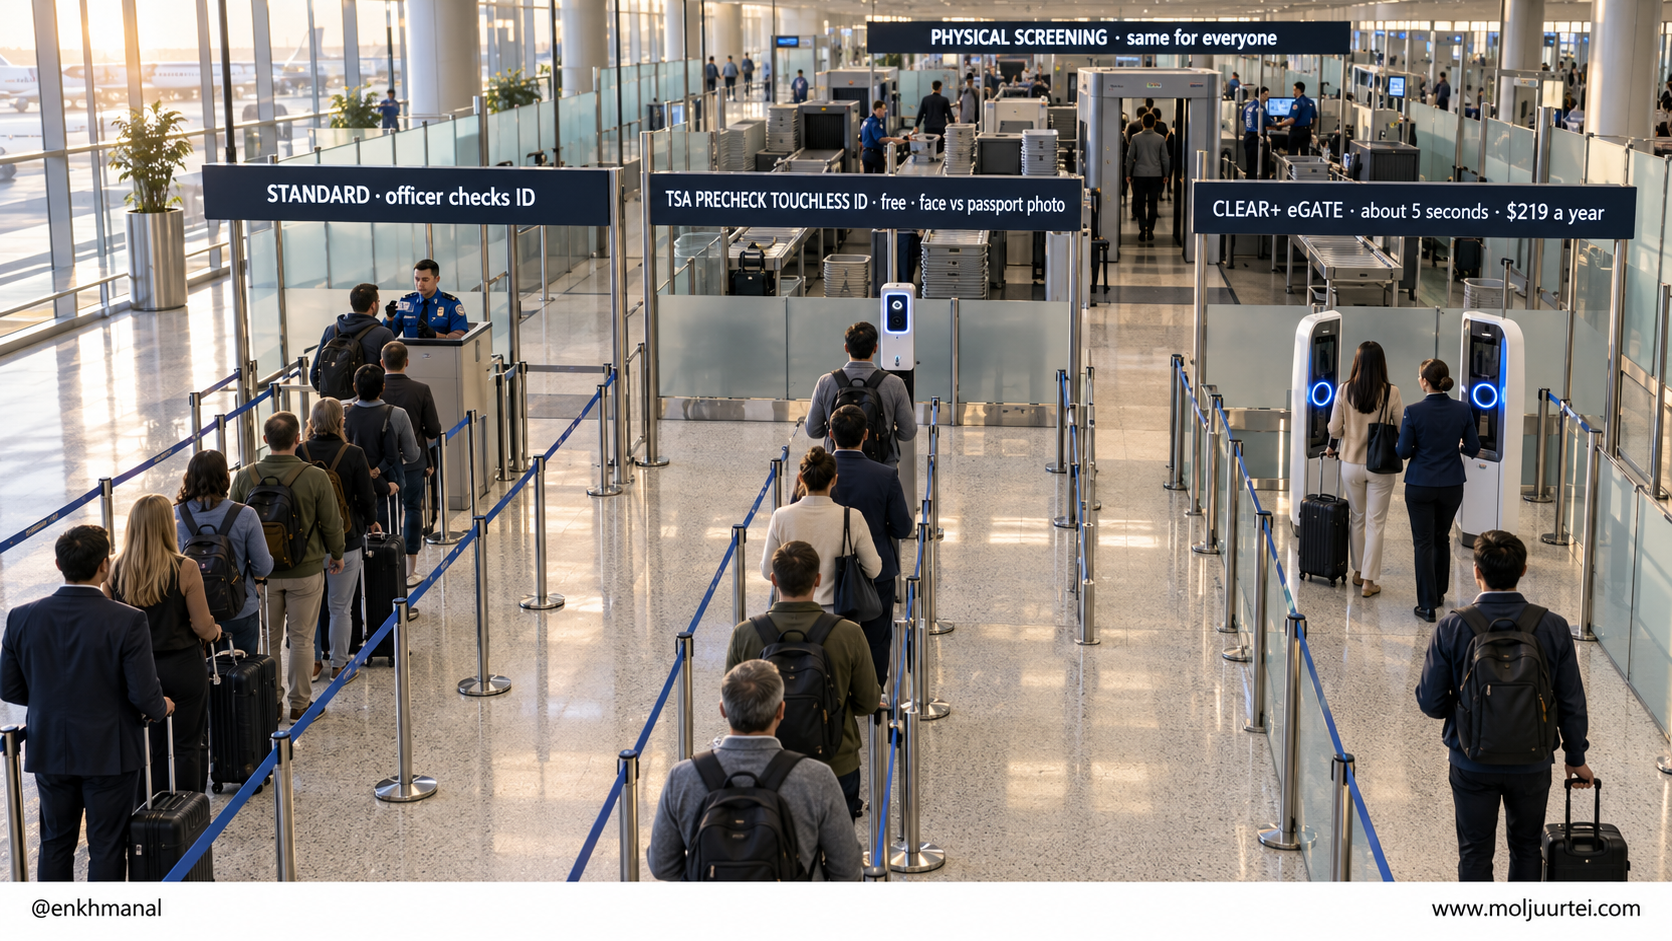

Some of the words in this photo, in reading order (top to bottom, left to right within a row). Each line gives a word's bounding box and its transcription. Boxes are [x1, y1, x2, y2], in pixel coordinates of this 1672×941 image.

[931, 28, 1011, 46] PHYSICAL
[1014, 28, 1108, 46] SCREENING
[1126, 32, 1170, 46] same
[1173, 27, 1199, 46] for
[1202, 32, 1278, 51] everyone
[266, 183, 371, 205] STANDARD
[385, 184, 444, 206] officer
[448, 185, 511, 207] checks
[516, 187, 536, 207] ID
[665, 190, 693, 208] TSA
[695, 190, 767, 209] PRECHECK
[769, 191, 850, 210] TOUCHLESS
[854, 192, 868, 210] ID
[880, 192, 907, 211] free
[918, 192, 947, 211] face
[949, 198, 964, 212] vs
[967, 196, 1024, 216] passport
[1027, 194, 1066, 217] photo
[1212, 199, 1282, 218] CLEAR+
[1287, 200, 1344, 219] eGATE
[1360, 201, 1407, 219] about
[1411, 202, 1421, 219] 5
[1425, 202, 1489, 220] seconds
[1506, 200, 1549, 223] $219
[1553, 208, 1563, 221] a
[1567, 208, 1606, 225] year
